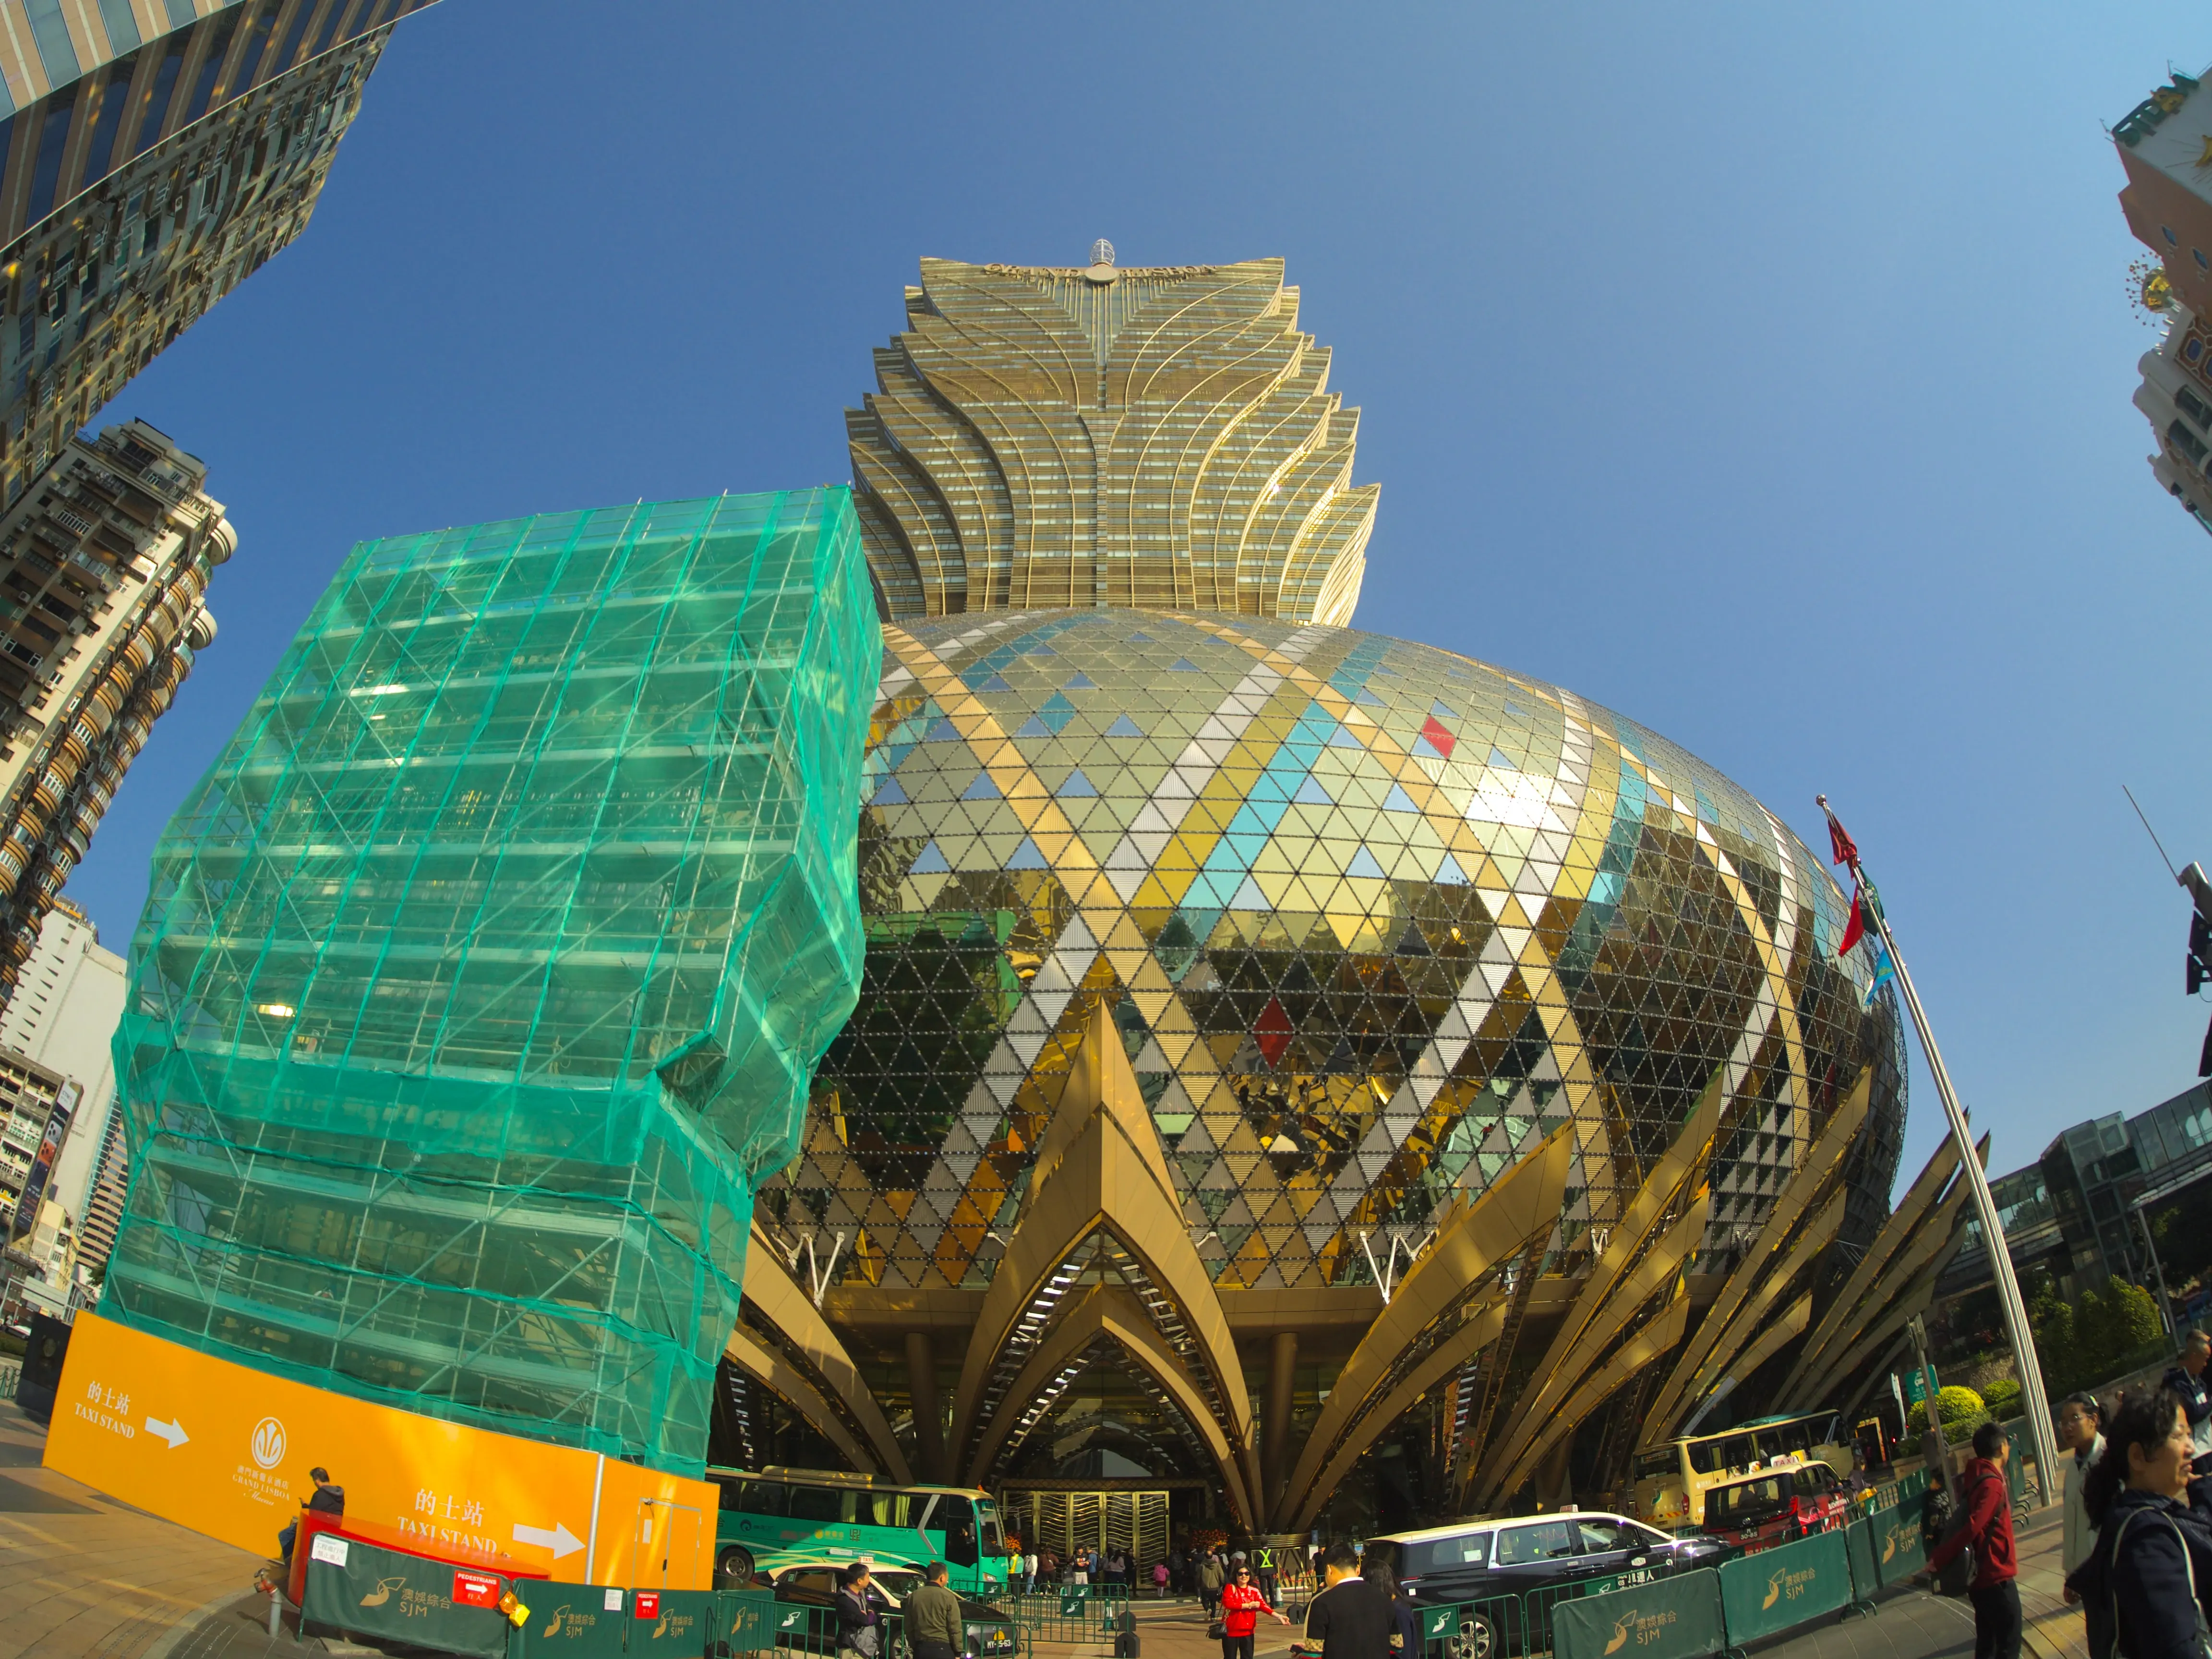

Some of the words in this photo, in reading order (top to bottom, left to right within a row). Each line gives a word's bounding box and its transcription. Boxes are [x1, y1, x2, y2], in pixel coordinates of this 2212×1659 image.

[1120, 263, 1218, 281] LISBOA
[87, 1380, 131, 1416] 的士站
[75, 1402, 99, 1424] TAXI
[99, 1414, 134, 1439] STAND
[1774, 1457, 1795, 1467] TAXI
[232, 1474, 259, 1489] GRAND
[261, 1484, 289, 1501] LISBOA
[243, 1489, 275, 1506] Macau
[415, 1488, 485, 1527] 的士站
[397, 1516, 436, 1539] TAXI
[440, 1528, 497, 1553] STAND
[1901, 1538, 1915, 1553] SJM
[457, 1573, 497, 1585] PEDESTRIANS
[468, 1593, 482, 1601] 行人
[1786, 1584, 1804, 1600] SJM
[399, 1601, 427, 1617] SJM
[566, 1626, 582, 1638] SJM
[670, 1626, 684, 1638] SJM
[1636, 1628, 1660, 1646] SJM
